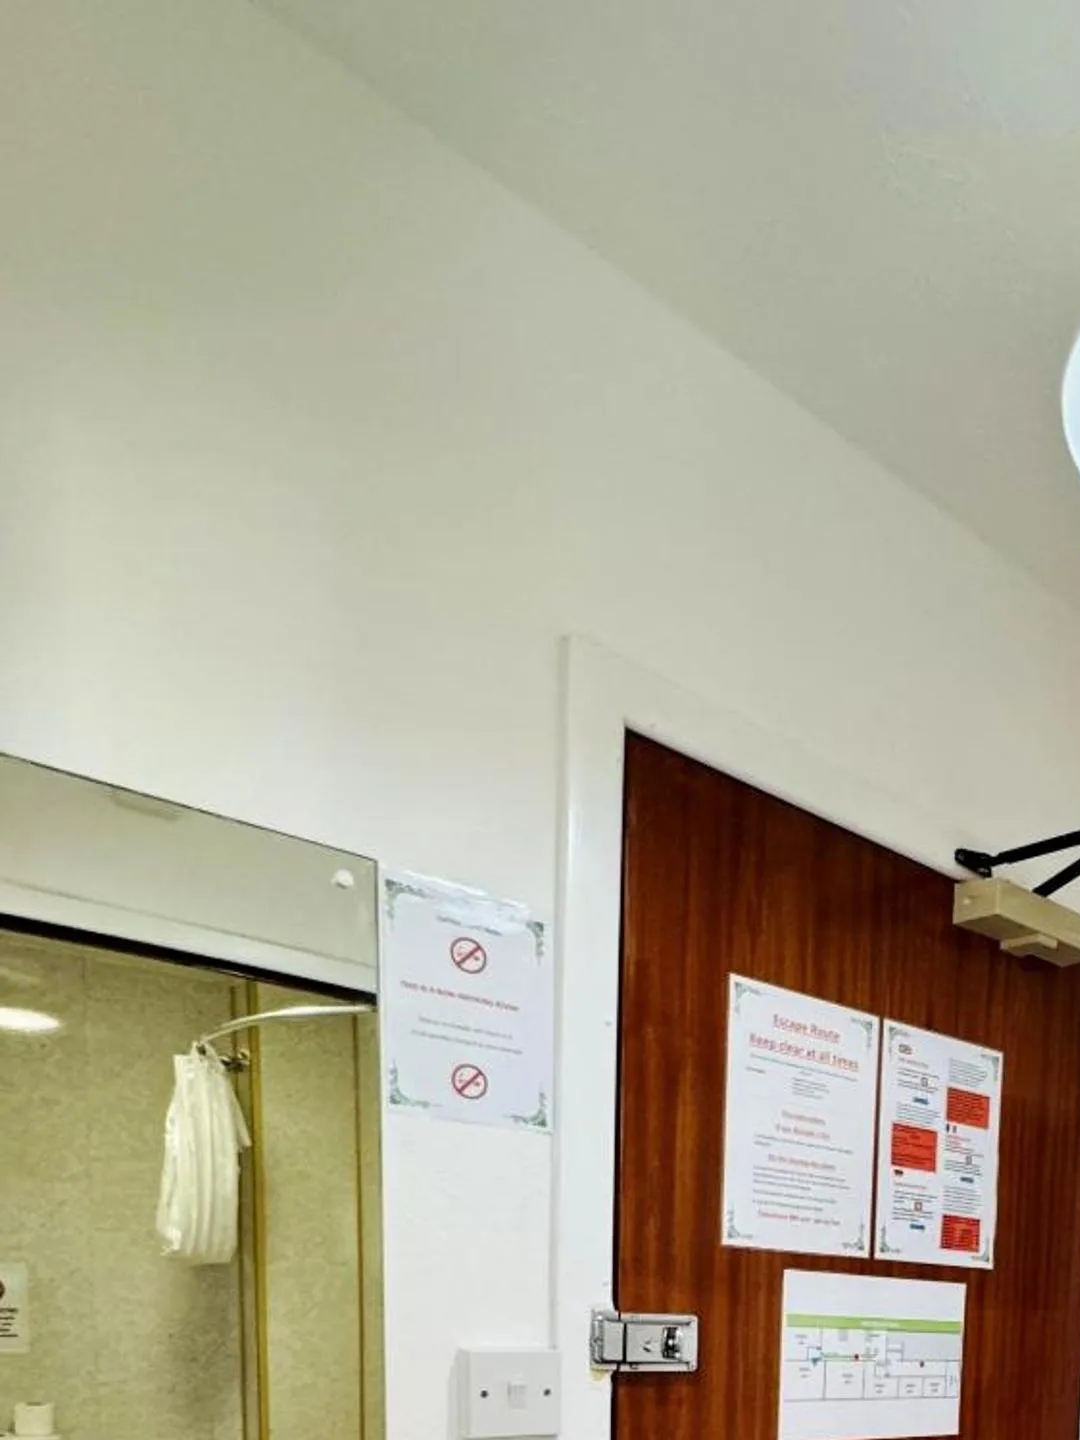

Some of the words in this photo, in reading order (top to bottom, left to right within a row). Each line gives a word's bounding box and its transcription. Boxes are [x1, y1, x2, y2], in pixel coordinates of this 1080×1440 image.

[772, 1013, 808, 1034] Escape
[810, 1023, 840, 1043] Route
[748, 1033, 777, 1052] Keep
[779, 1040, 805, 1057] clear
